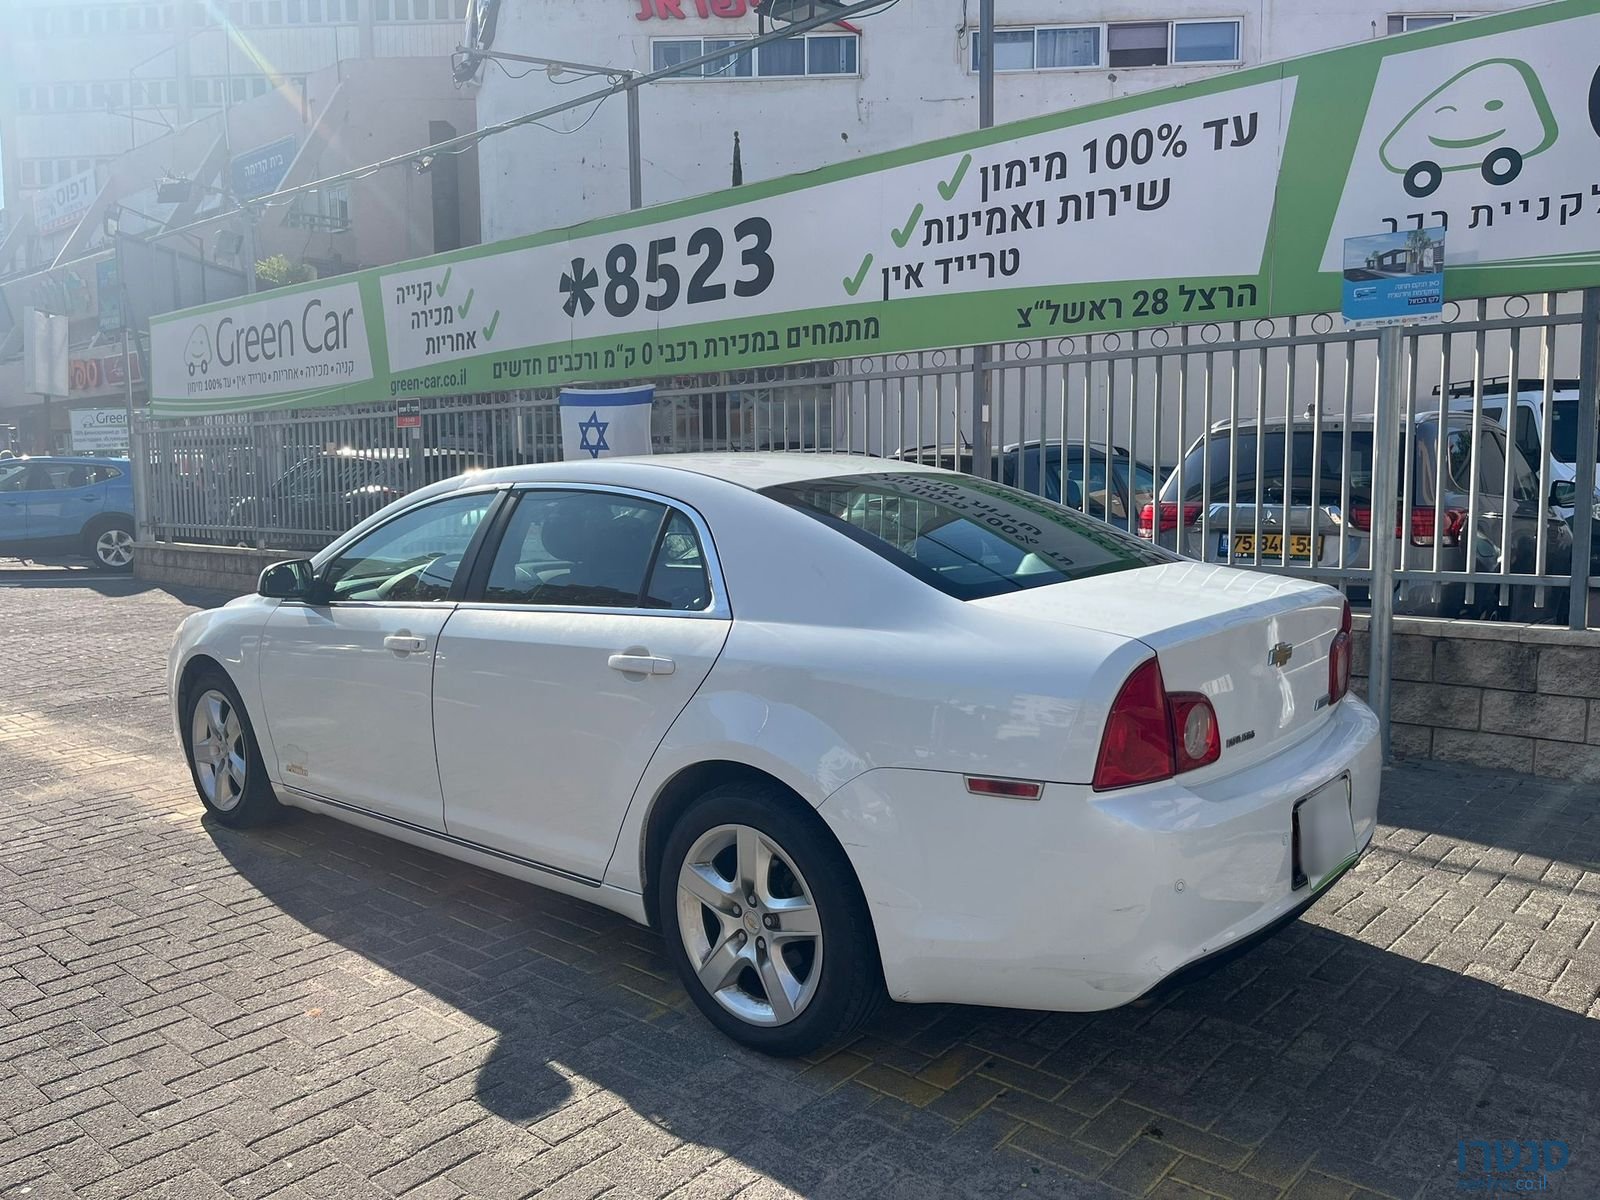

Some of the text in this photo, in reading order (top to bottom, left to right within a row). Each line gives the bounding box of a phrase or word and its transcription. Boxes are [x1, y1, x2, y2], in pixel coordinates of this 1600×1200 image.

[979, 112, 1259, 203] עד 100% מימון
[56, 177, 88, 206] דפוס
[922, 177, 1171, 247] שירות ואמינות
[881, 247, 1020, 301] טרייד אין
[396, 281, 433, 306] קנייה
[1132, 288, 1168, 317] 28
[1178, 282, 1257, 312] הרצל
[411, 305, 454, 330] מכירה
[216, 299, 354, 367] Green Car
[425, 330, 477, 355] אחריות
[703, 330, 780, 359] במכירת
[786, 316, 880, 349] מתמחים
[547, 351, 598, 374] ורכבים
[641, 342, 653, 365] 0
[657, 340, 698, 363] רכבי
[248, 372, 267, 385] טרייד
[273, 367, 299, 382] אחריות
[305, 363, 329, 378] מכירה
[336, 360, 354, 377] קניה
[493, 357, 542, 379] חדשים
[204, 378, 223, 391] 100%
[223, 376, 231, 389] עד
[236, 375, 246, 390] אין
[390, 368, 467, 396] green-car.co.il
